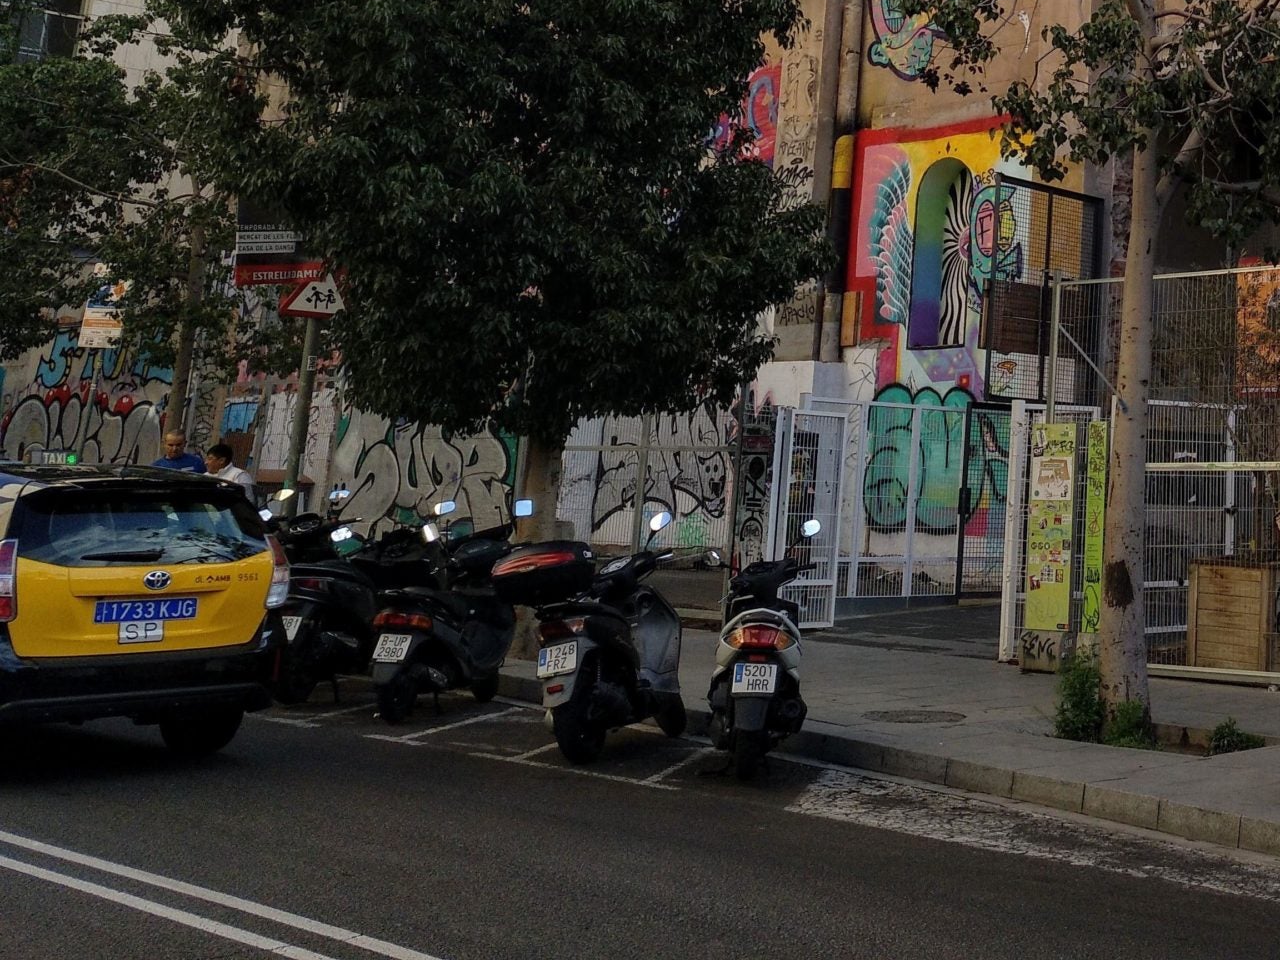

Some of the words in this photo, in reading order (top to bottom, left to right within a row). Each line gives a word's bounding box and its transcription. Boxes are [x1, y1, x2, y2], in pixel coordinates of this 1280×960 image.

[43, 452, 66, 464] TAXI
[111, 602, 155, 620] 1733
[159, 600, 193, 618] KJG
[376, 646, 403, 659] 2980
[549, 643, 576, 659] 1248
[744, 664, 773, 678] 5201
[746, 678, 770, 691] HRR
